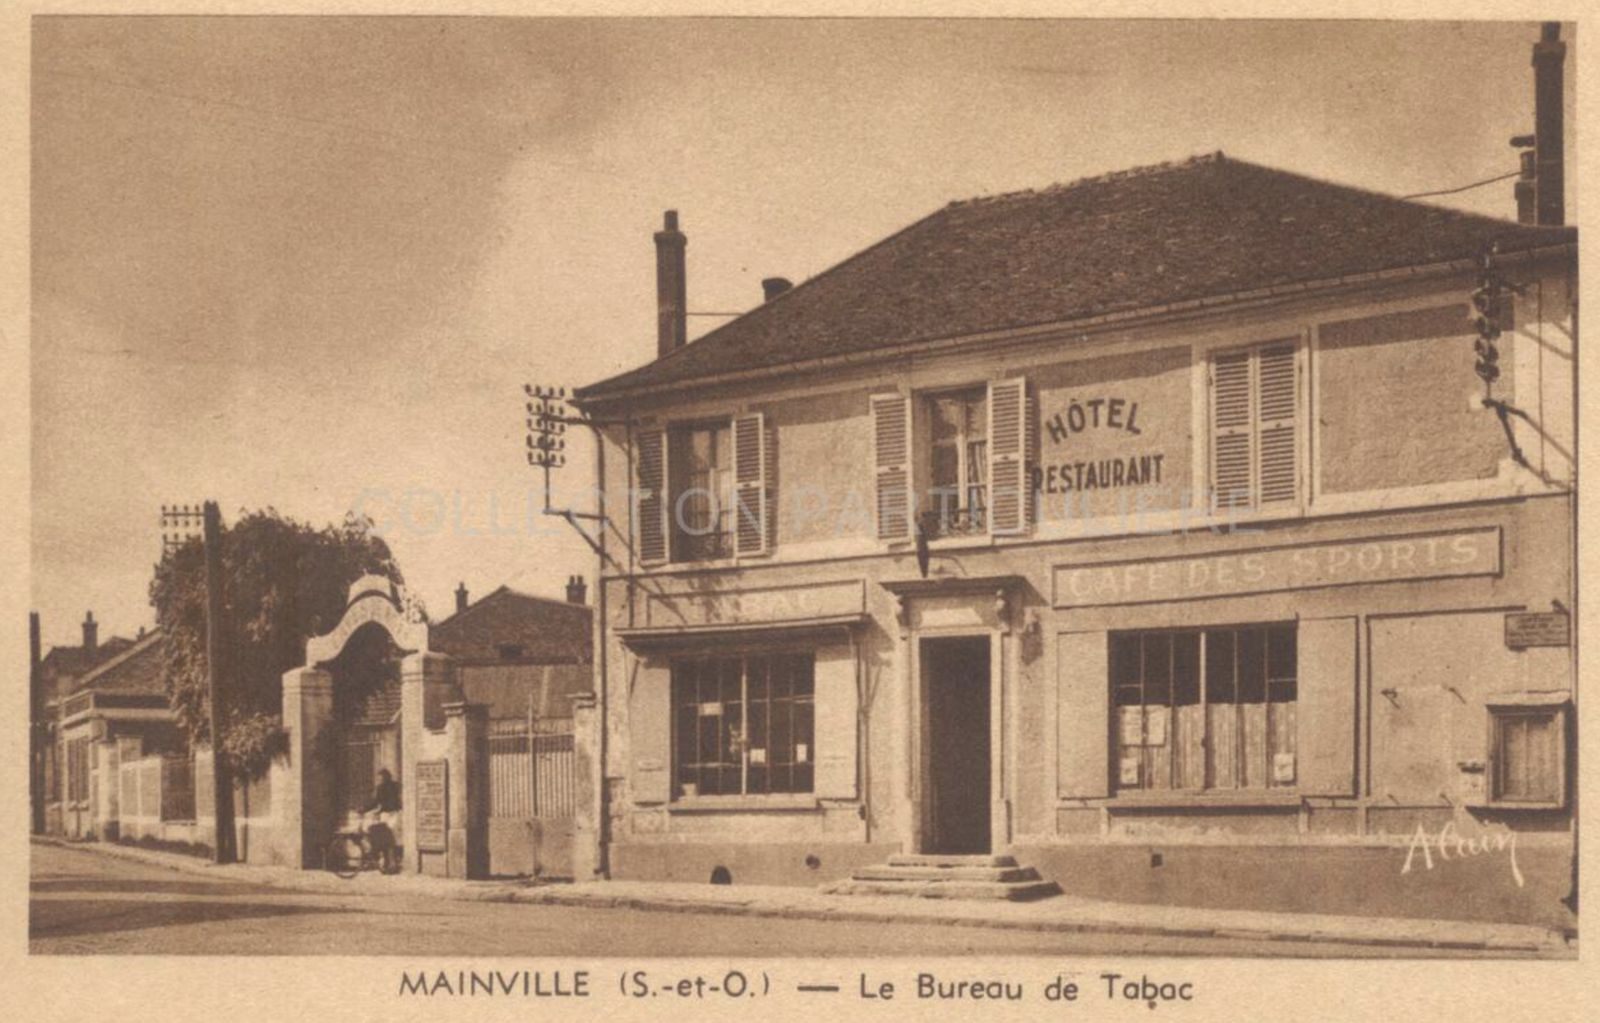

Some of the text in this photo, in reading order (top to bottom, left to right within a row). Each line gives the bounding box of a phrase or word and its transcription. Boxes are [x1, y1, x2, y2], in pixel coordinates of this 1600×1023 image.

[1045, 397, 1142, 445] HÔTEL
[1032, 453, 1165, 495] RESTAURANT
[1187, 555, 1266, 589] DES
[1291, 535, 1478, 575] SPORTS
